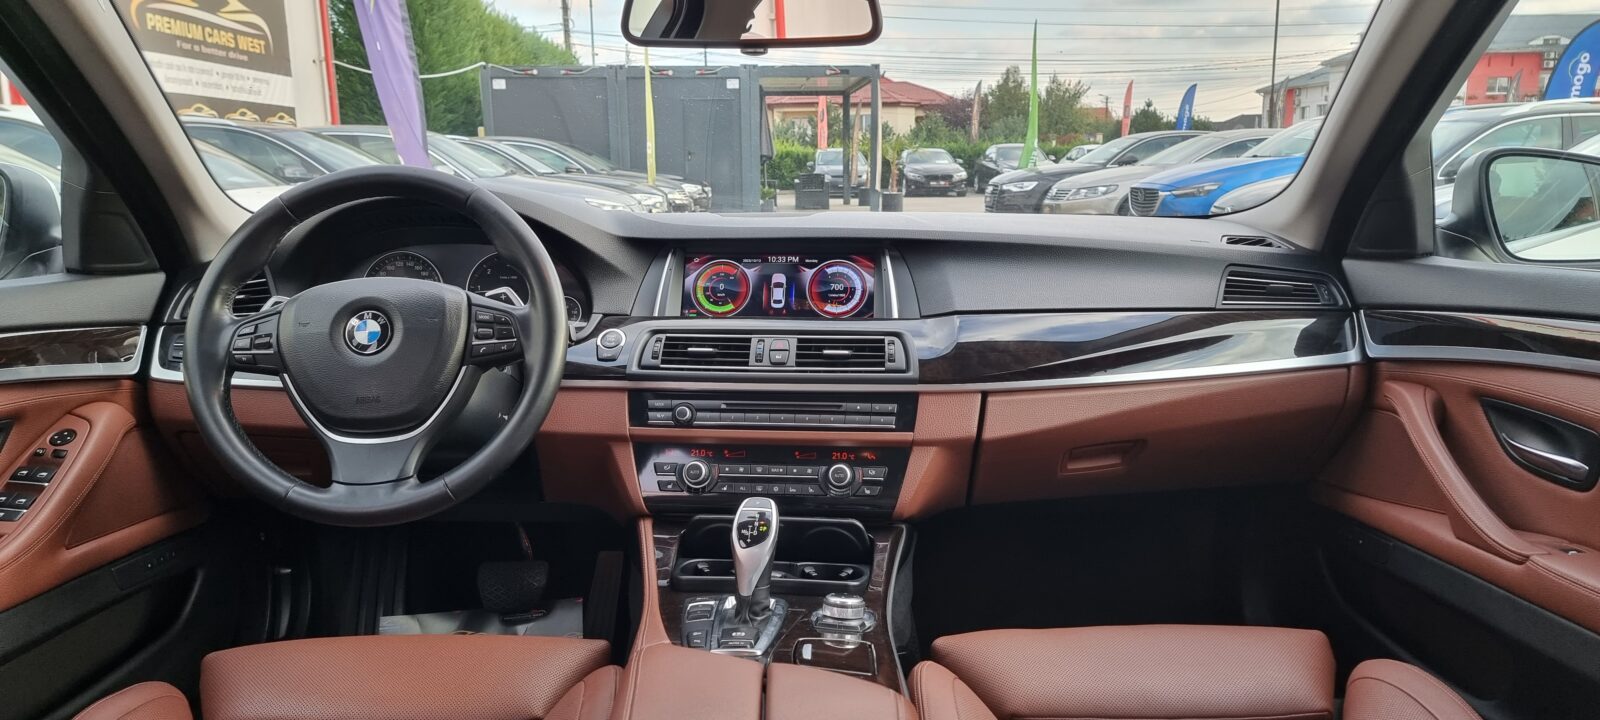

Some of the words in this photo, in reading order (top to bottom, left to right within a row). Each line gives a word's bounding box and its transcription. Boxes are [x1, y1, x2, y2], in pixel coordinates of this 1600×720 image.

[145, 12, 204, 41] PREMIUM
[203, 26, 235, 49] CARS
[236, 34, 266, 55] WEST
[176, 40, 192, 50] For
[200, 44, 227, 57] better
[227, 51, 249, 61] drive
[1570, 52, 1592, 98] mogo
[829, 283, 844, 291] 700
[690, 448, 706, 457] 21.0
[832, 452, 848, 460] 21.0
